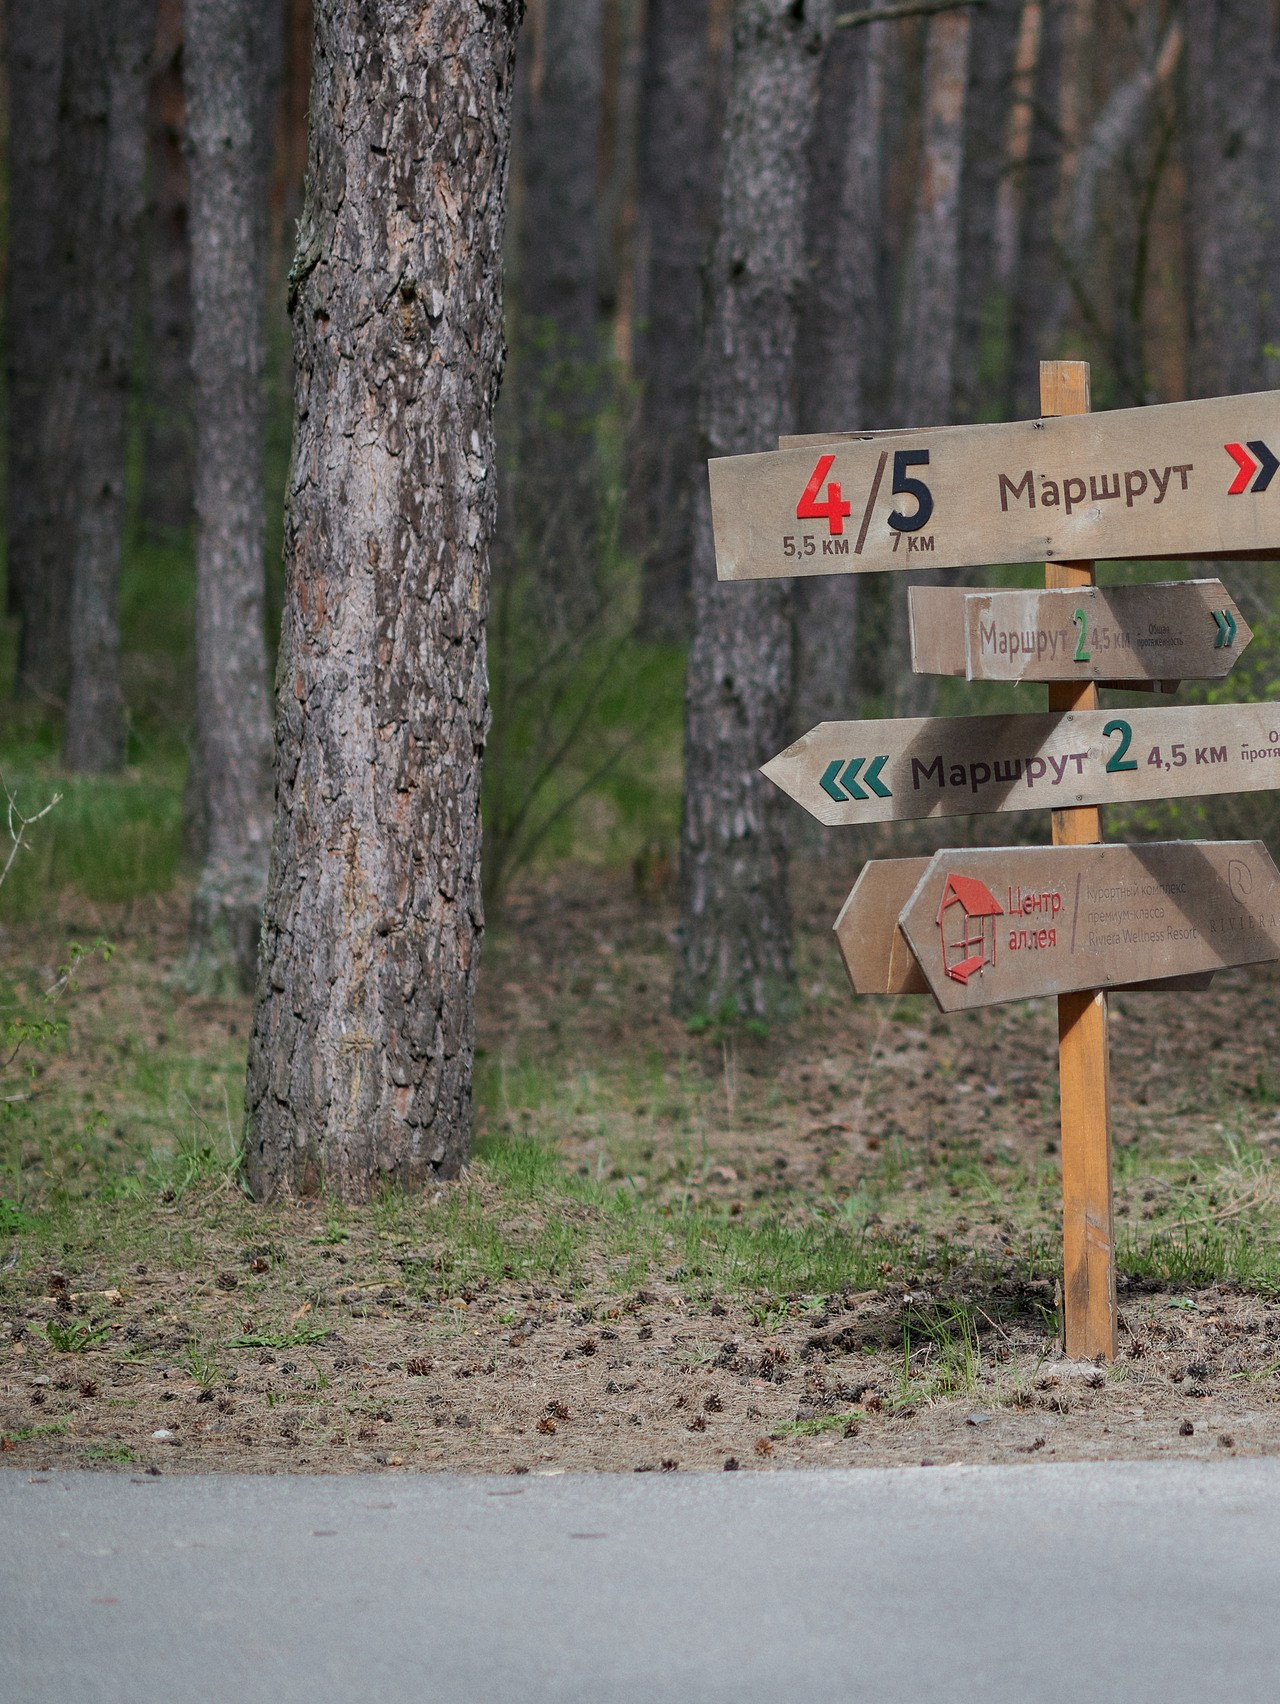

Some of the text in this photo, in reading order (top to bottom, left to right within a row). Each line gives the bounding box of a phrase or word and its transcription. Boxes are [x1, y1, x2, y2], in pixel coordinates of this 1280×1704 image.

[998, 463, 1194, 515] Маршрут
[783, 535, 849, 559] 5,5 км
[889, 532, 935, 552] 7 км
[980, 608, 1130, 663] Маршрут 2 4,5 км
[911, 719, 1228, 793] Маршрут 2 4,5 км
[1086, 881, 1187, 903] Курортный комплекс
[1087, 907, 1166, 926] премиум-класса
[1209, 913, 1278, 933] RIVIERA
[1008, 928, 1057, 951] аллея
[1088, 925, 1198, 947] Riviera Wellness Resort
